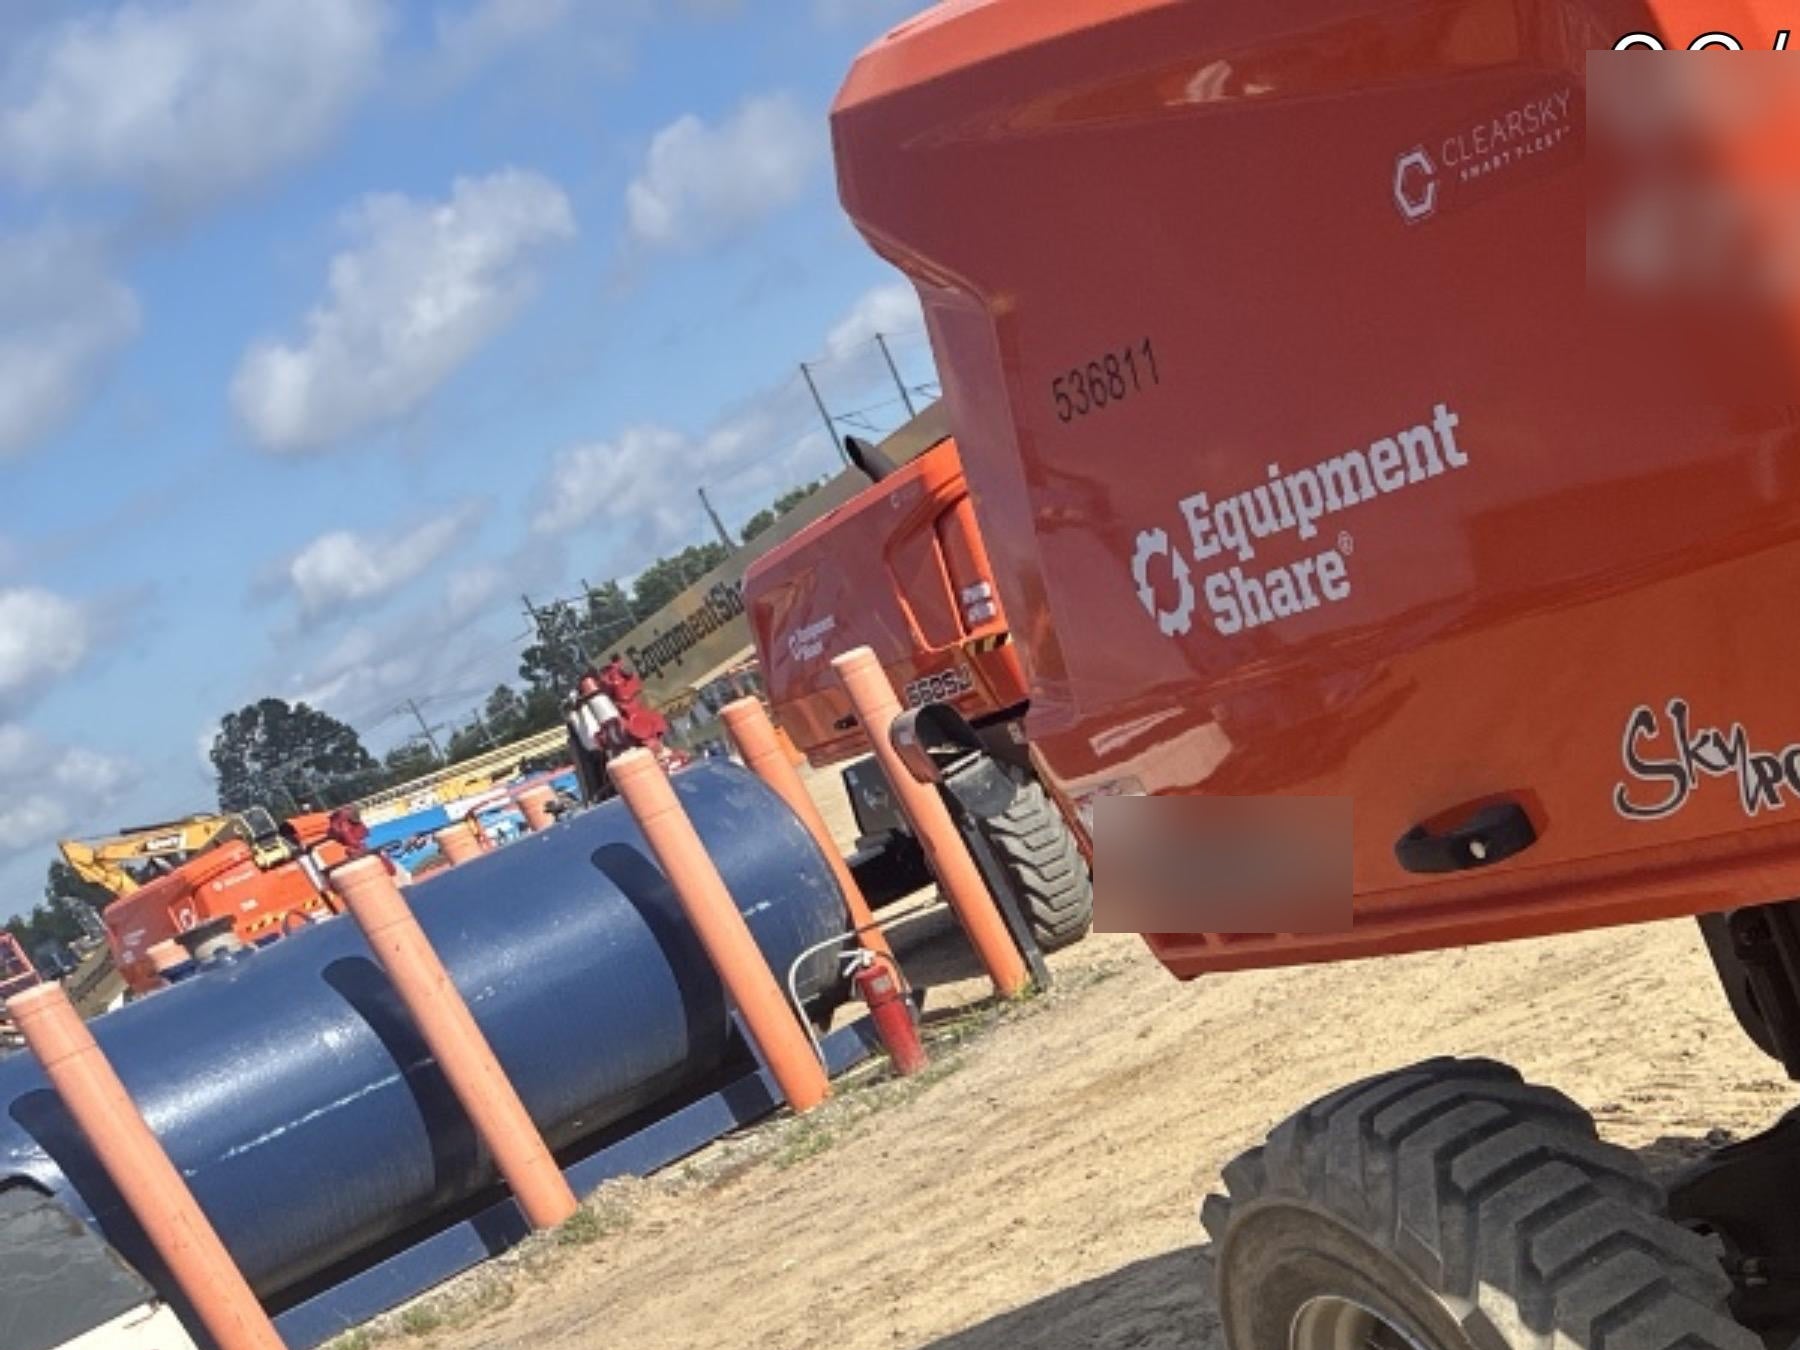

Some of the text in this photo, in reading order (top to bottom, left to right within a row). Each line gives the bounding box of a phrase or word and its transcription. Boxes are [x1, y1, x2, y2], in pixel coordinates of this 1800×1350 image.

[1442, 87, 1572, 166] CLEARSKY
[1050, 338, 1163, 425] 536811
[1179, 402, 1468, 563] Equipment
[626, 579, 746, 681] EquipmentSh
